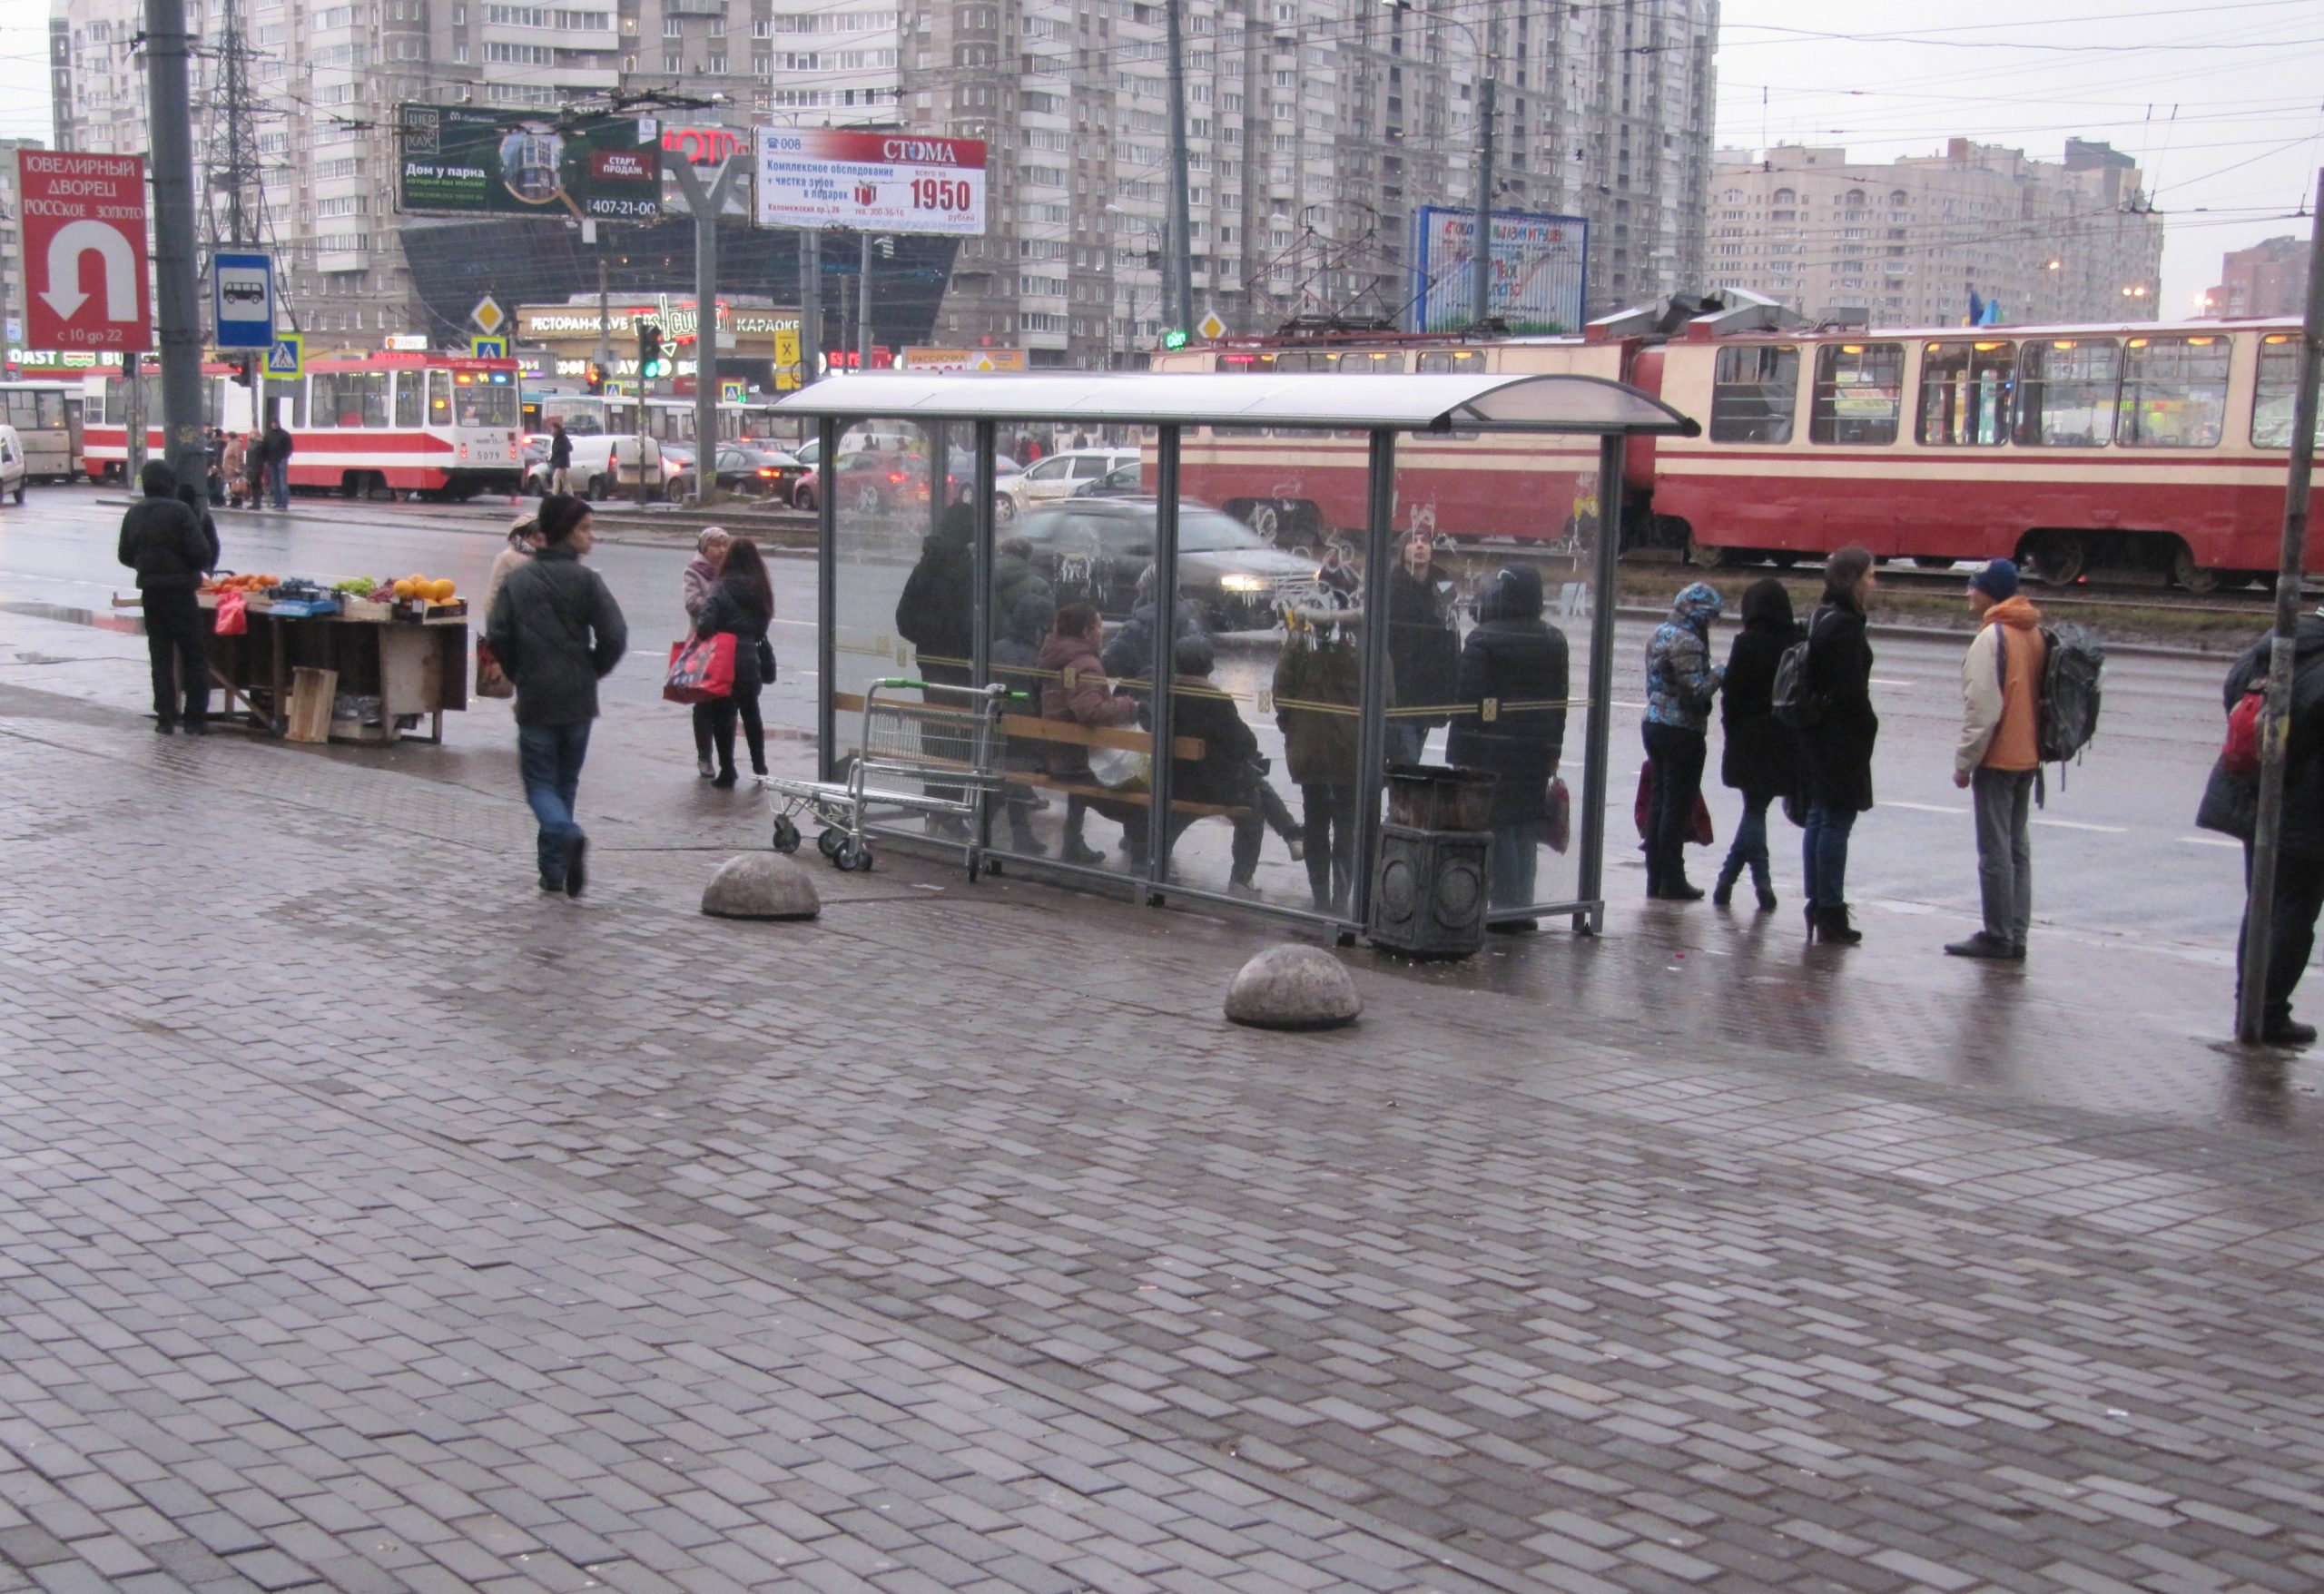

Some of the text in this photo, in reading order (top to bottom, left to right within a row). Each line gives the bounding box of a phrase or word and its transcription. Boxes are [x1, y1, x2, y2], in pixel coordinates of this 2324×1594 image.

[781, 138, 802, 151] 008
[883, 139, 957, 162] СТОМА
[26, 156, 135, 177] ЮВЕЛИРНЫЙ
[609, 156, 636, 166] СТАРТ
[767, 159, 894, 177] Комплексное обследование
[406, 162, 433, 176] Дом
[437, 167, 445, 179] у
[603, 164, 643, 175] ПРОДАЖ
[47, 179, 117, 198] ДВОРЕЦ
[775, 176, 806, 187] чистка
[809, 176, 834, 190] зубов
[812, 189, 849, 202] подарок
[910, 178, 970, 212] 1950
[593, 200, 656, 215] 407-21-00
[70, 329, 85, 341] 10
[106, 329, 123, 341] 22
[477, 451, 500, 460] 5079
